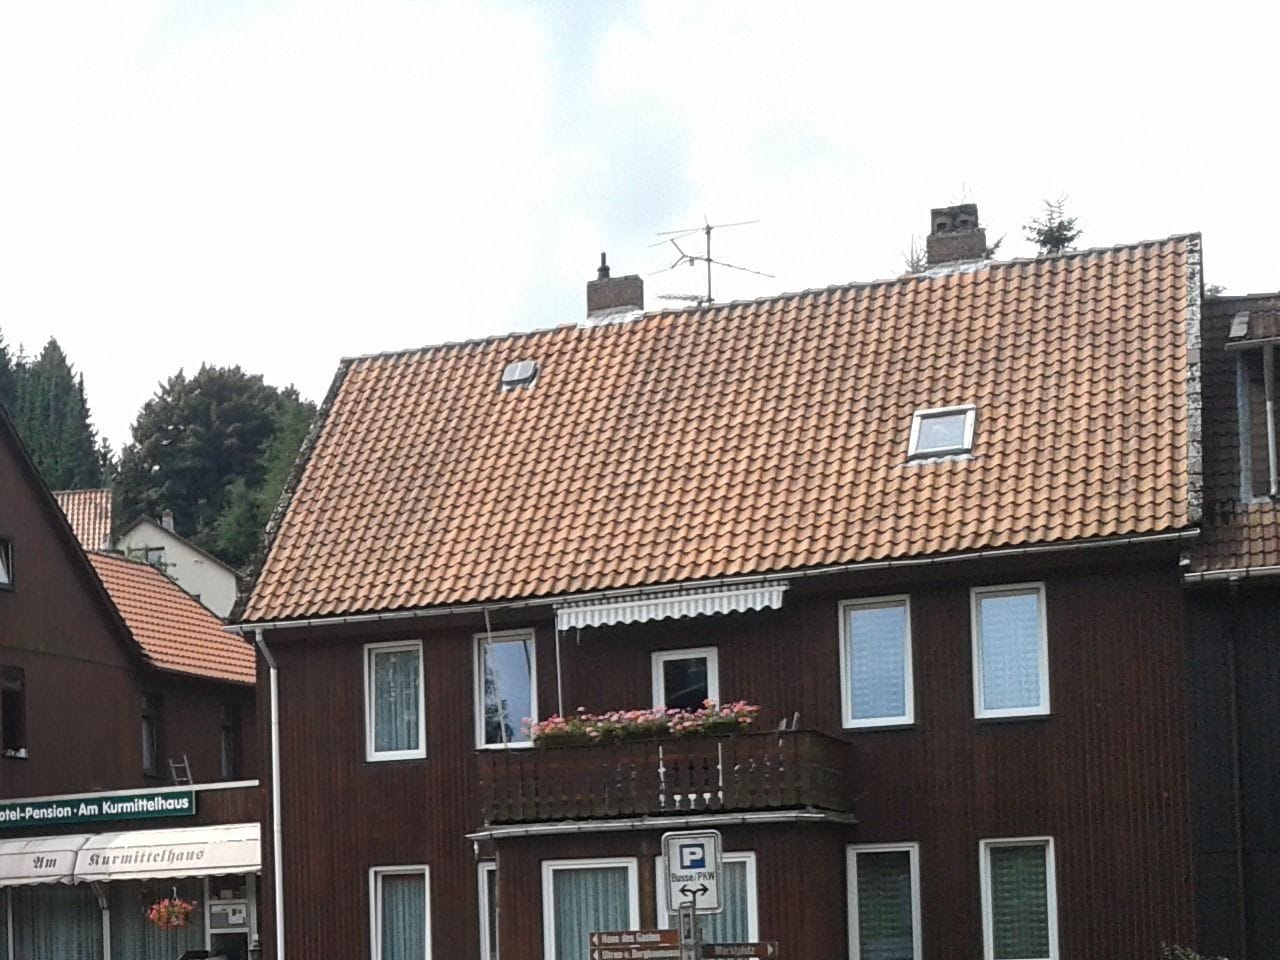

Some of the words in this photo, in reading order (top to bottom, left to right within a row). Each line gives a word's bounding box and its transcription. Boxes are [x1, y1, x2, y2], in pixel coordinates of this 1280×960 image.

[78, 802, 99, 816] Am
[102, 796, 189, 815] Kurmittelhaus
[32, 855, 57, 870] Am
[88, 848, 205, 867] Kurmittelhaus
[682, 847, 703, 866] P
[671, 871, 715, 882] Busse/PKW
